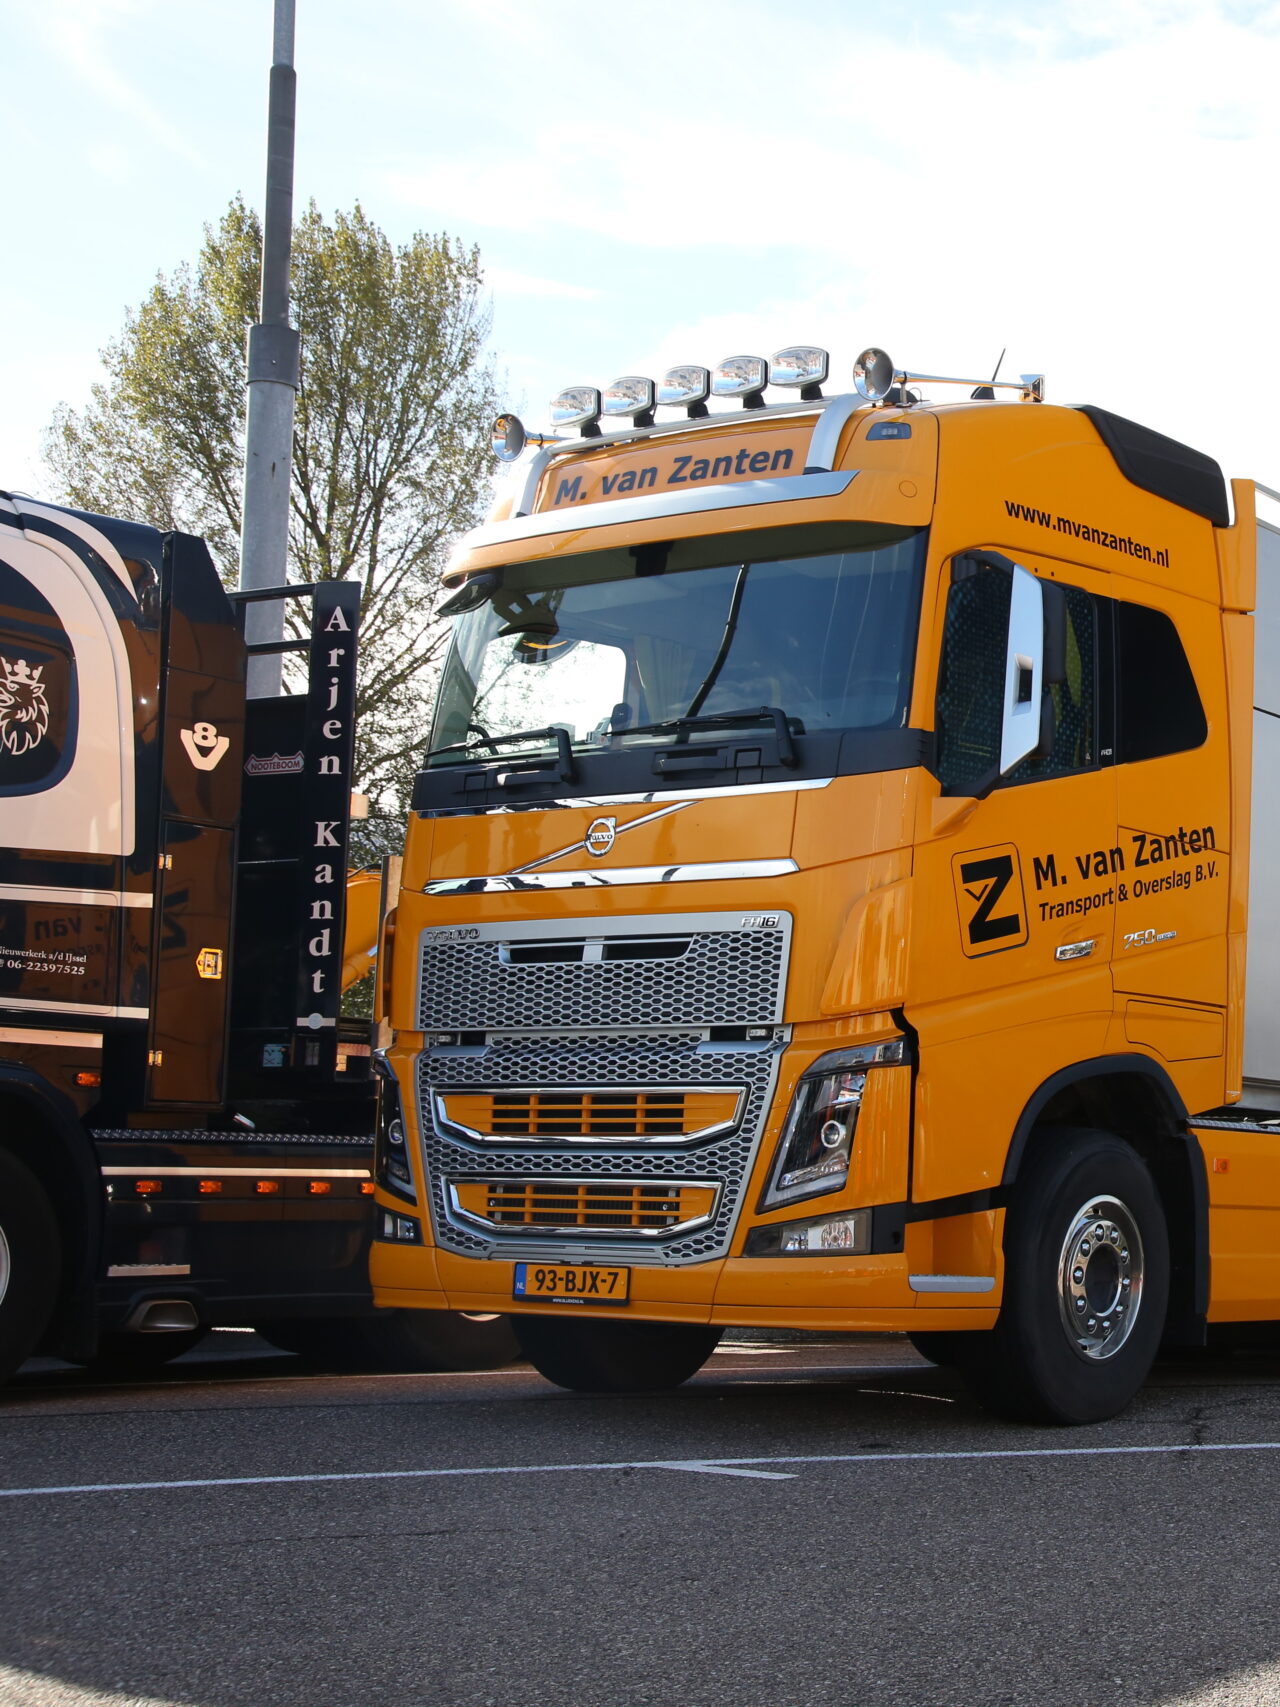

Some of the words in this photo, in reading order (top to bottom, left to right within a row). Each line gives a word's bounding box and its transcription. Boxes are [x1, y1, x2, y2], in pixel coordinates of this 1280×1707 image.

[554, 475, 588, 506] M.
[601, 466, 658, 496] van
[667, 447, 794, 485] Zanten
[1004, 499, 1170, 569] www.mvanzanten.nl
[317, 605, 352, 776] Arjen
[250, 760, 301, 772] NOOTEBOOM
[1032, 853, 1068, 891] M.
[1075, 845, 1126, 881] van
[1131, 824, 1217, 868] Zanten
[1038, 886, 1115, 922] Transport
[1116, 883, 1129, 902] &
[1133, 869, 1192, 898] Overslag
[1194, 861, 1220, 883] B.V.
[308, 820, 342, 994] Kandt
[741, 915, 779, 928] FH16
[1123, 928, 1156, 950] 750
[0, 945, 47, 959] ieuwerkerk
[48, 951, 64, 961] a/d
[65, 953, 87, 963] IJssel
[7, 959, 86, 975] 06-22397525
[516, 1282, 525, 1290] NL
[534, 1268, 620, 1294] 93-BJX-7
